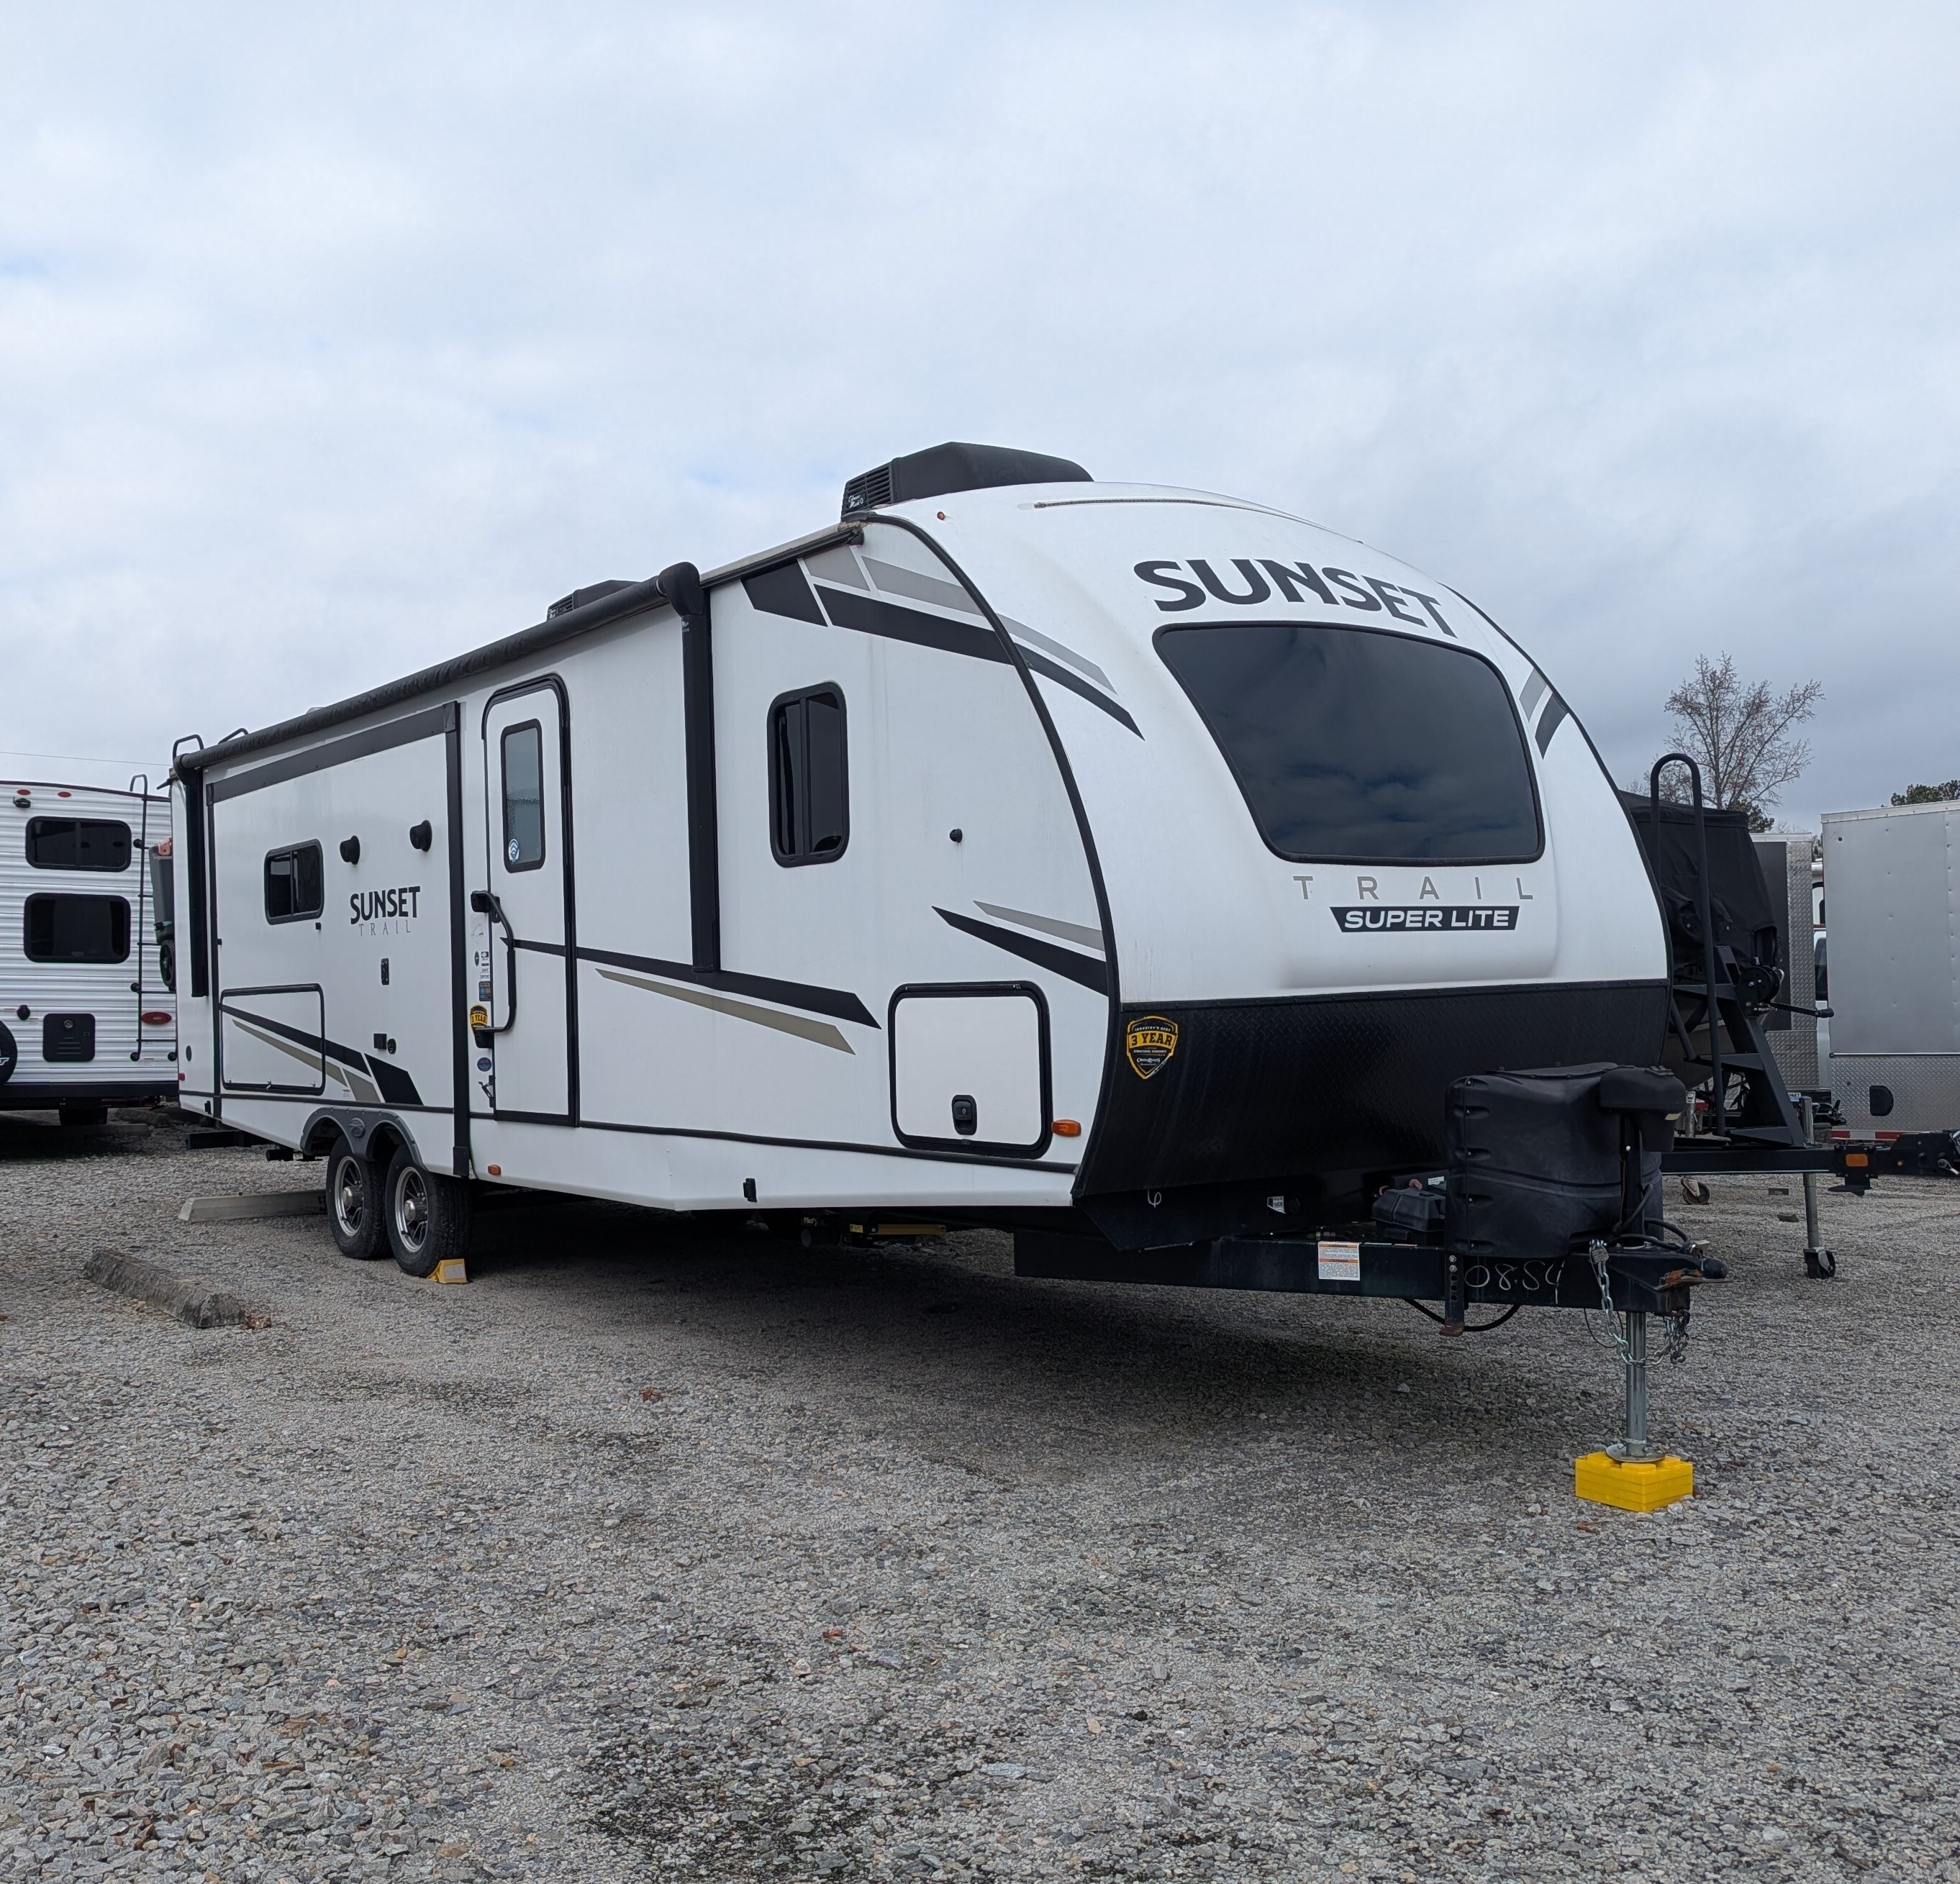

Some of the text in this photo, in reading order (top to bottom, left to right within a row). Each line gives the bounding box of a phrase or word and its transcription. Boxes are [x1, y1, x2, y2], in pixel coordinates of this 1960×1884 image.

[1133, 559, 1458, 639] SUNSET
[1292, 875, 1534, 901] TRAIL
[350, 886, 421, 925] SUNSET
[358, 919, 412, 937] TRAIL
[1344, 910, 1510, 929] SUPER LITE
[1131, 1032, 1173, 1047] 3 YEAR
